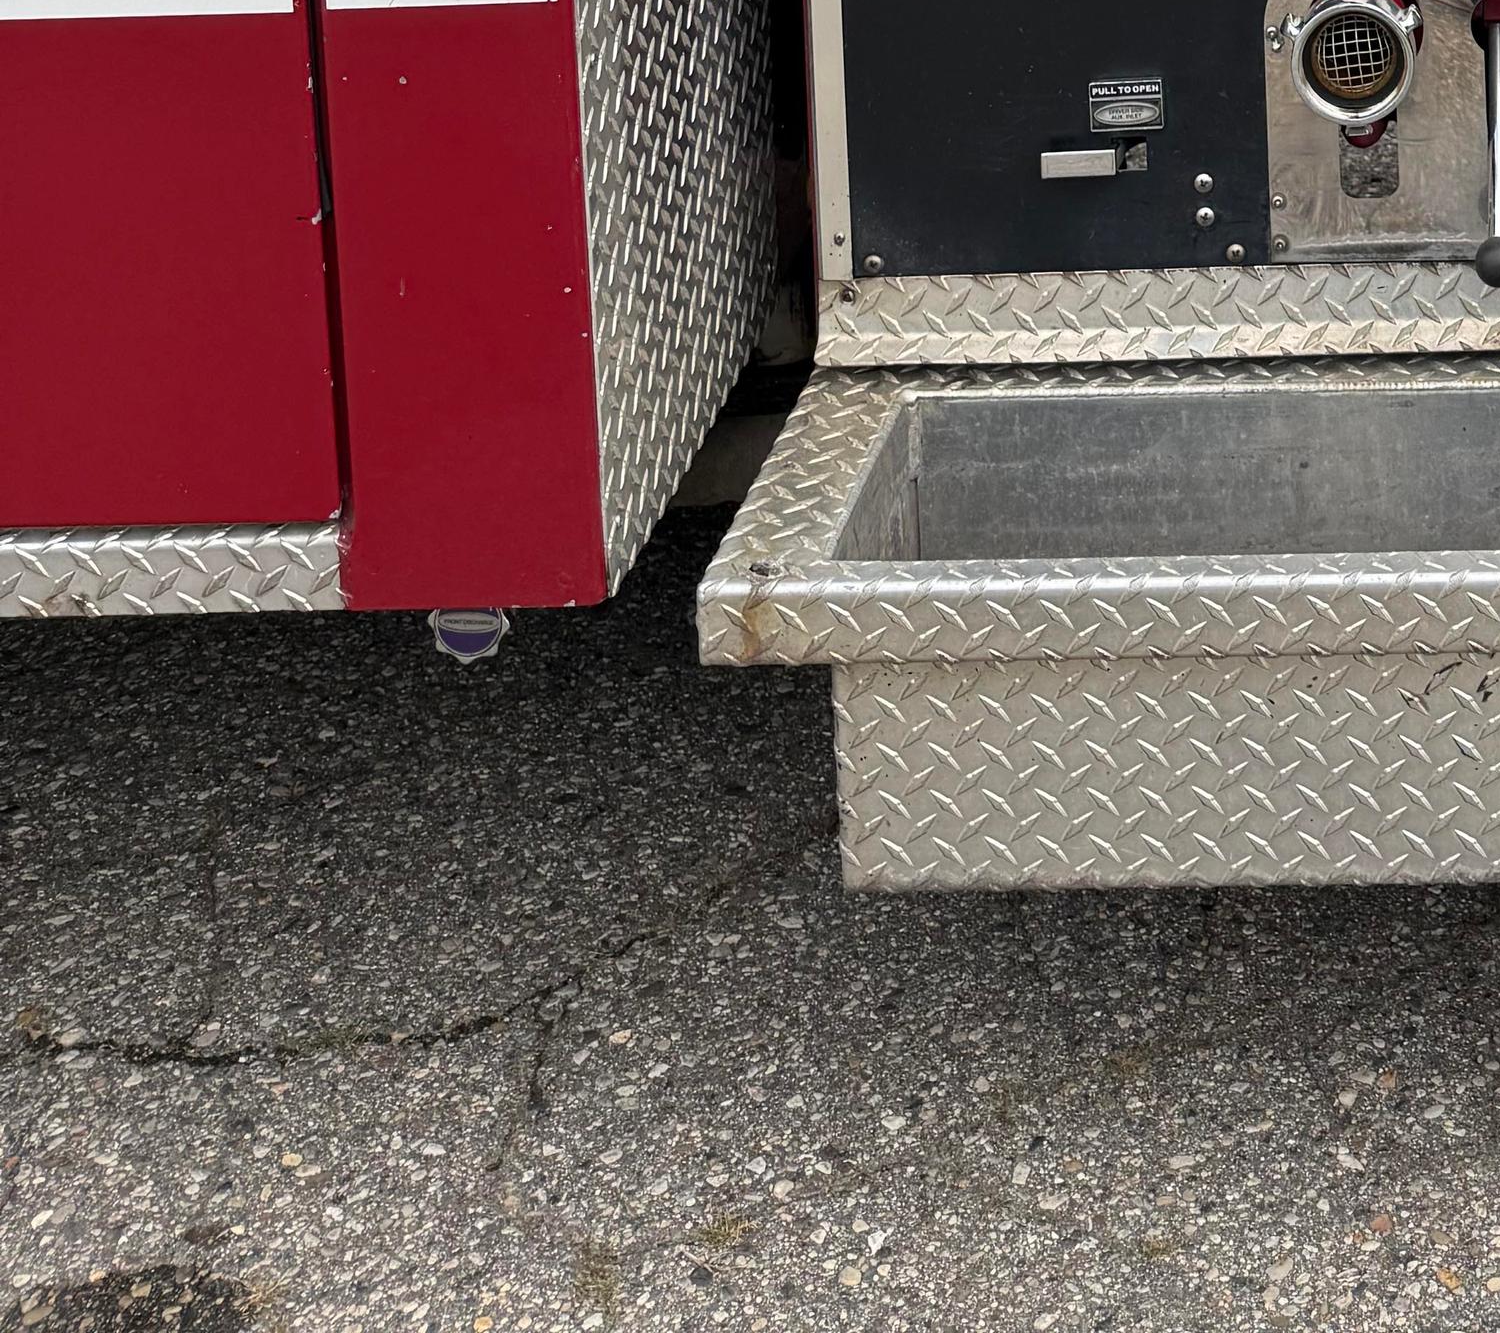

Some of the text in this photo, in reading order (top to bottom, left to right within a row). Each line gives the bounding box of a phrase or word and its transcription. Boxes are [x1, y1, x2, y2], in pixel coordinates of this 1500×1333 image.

[1092, 84, 1159, 95] PULL TO OPEN
